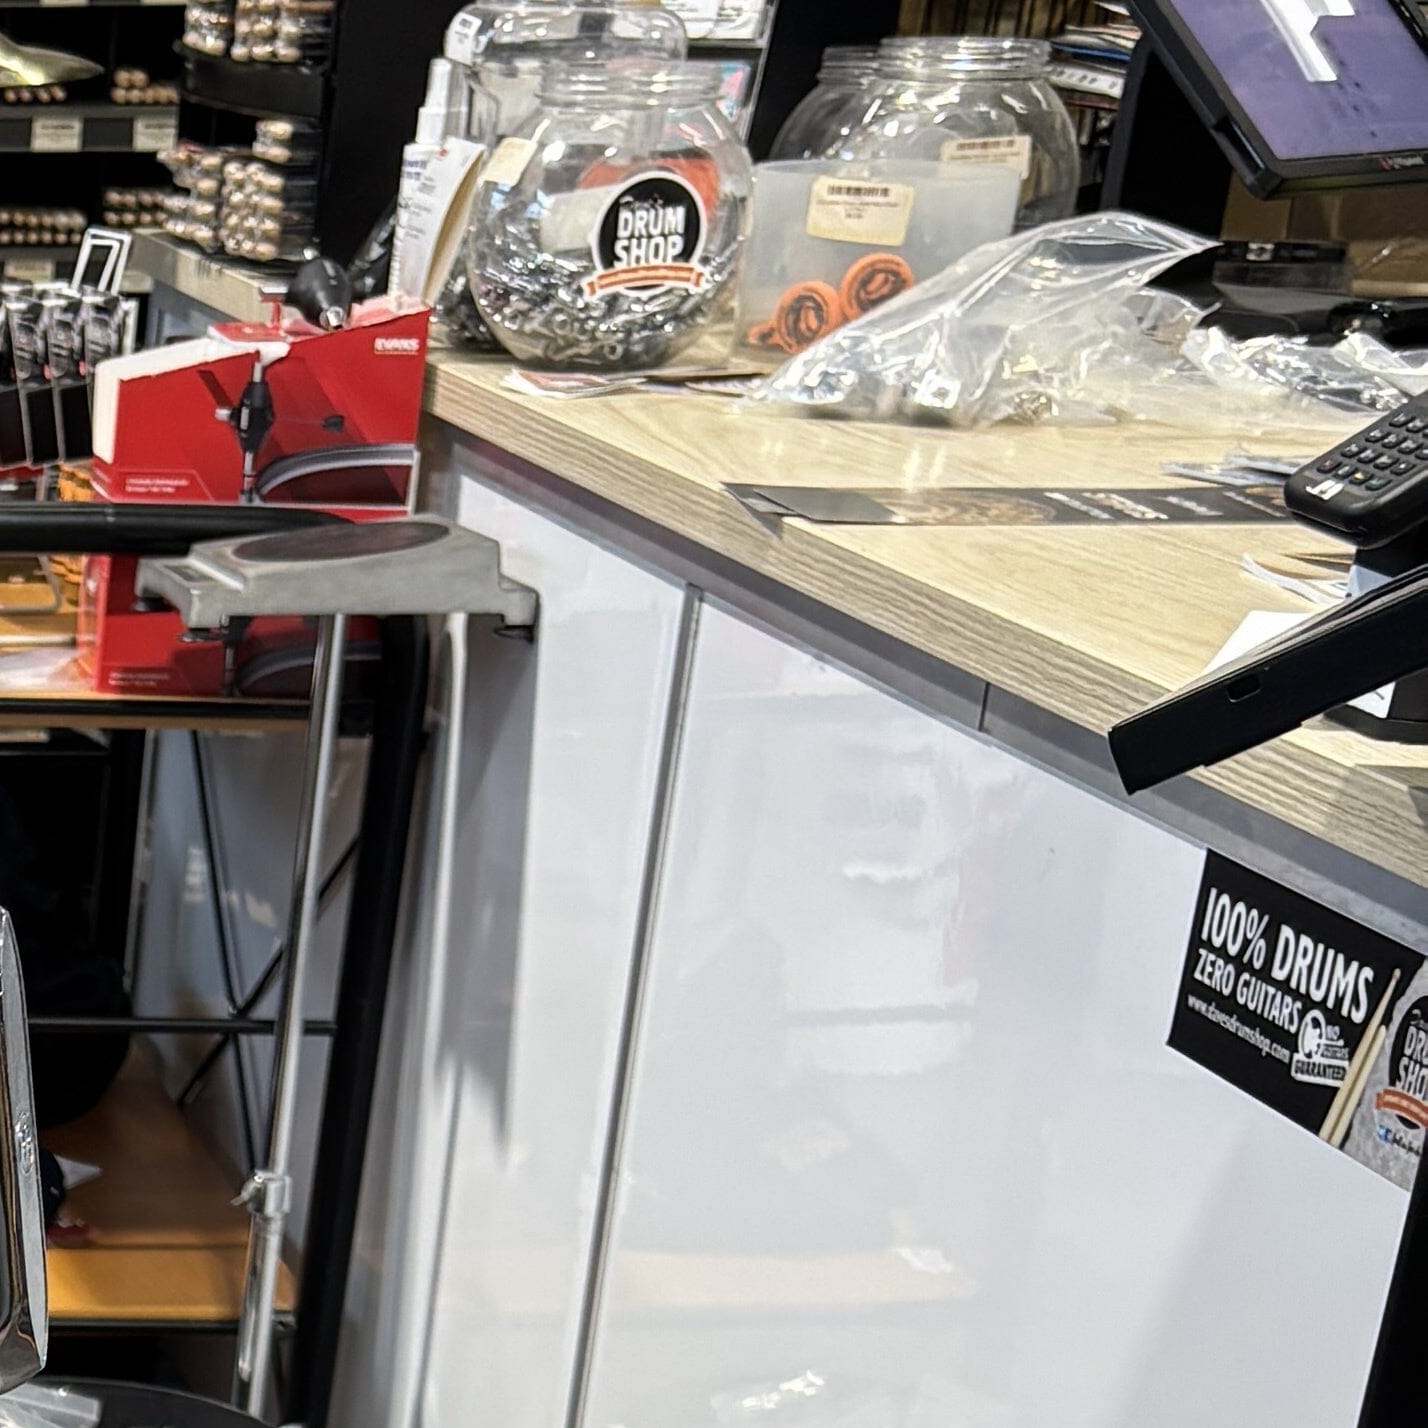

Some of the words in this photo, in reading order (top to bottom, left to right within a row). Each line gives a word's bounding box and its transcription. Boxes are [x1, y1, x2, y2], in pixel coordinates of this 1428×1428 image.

[612, 234, 685, 269] SHOP
[617, 205, 687, 238] DRUM
[1200, 886, 1270, 970] 100%
[1270, 923, 1375, 1025] DRUMS
[1194, 948, 1236, 996] ZERO
[1236, 971, 1303, 1034] GUITARS
